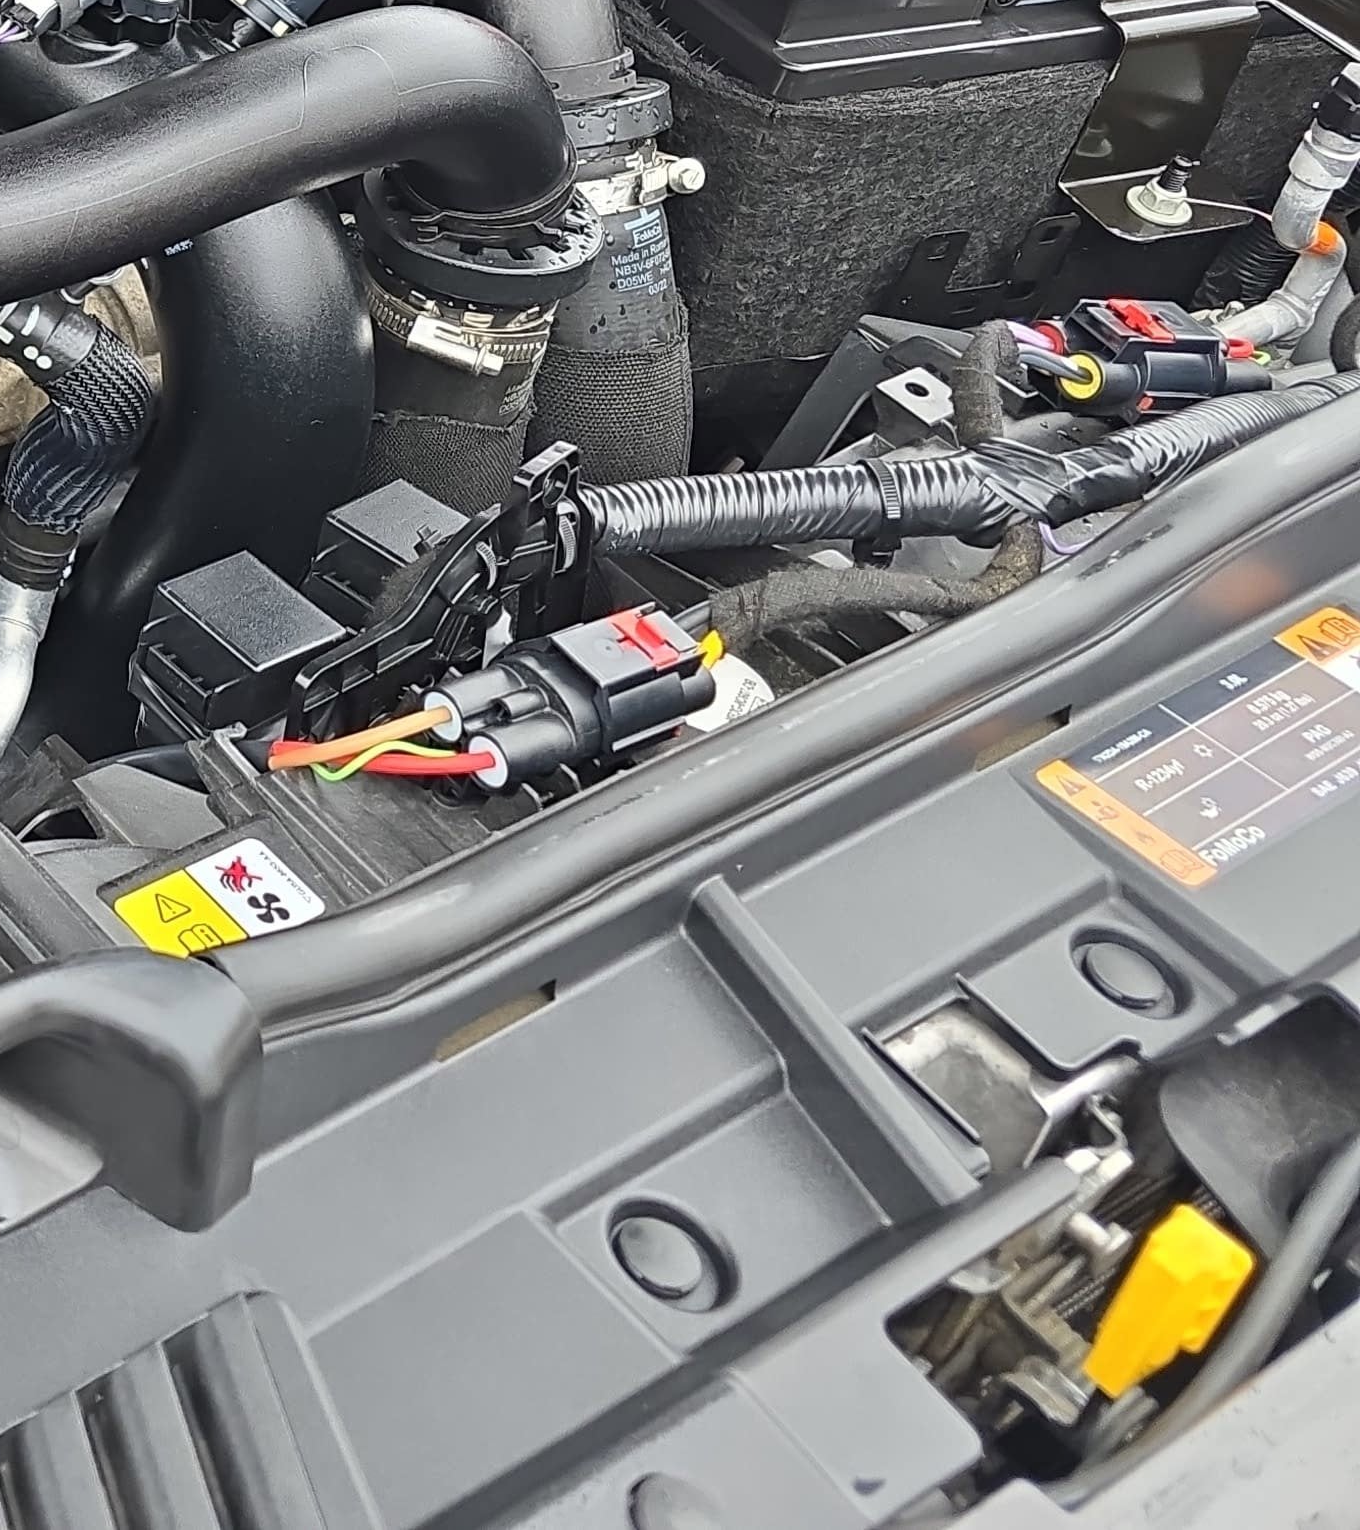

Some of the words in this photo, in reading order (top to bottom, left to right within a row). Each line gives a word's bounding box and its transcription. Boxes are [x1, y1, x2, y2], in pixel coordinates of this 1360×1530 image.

[611, 251, 639, 267] Made
[617, 271, 654, 289] D05WE
[648, 278, 668, 296] 03/22
[1199, 825, 1266, 867] FoMoCo
